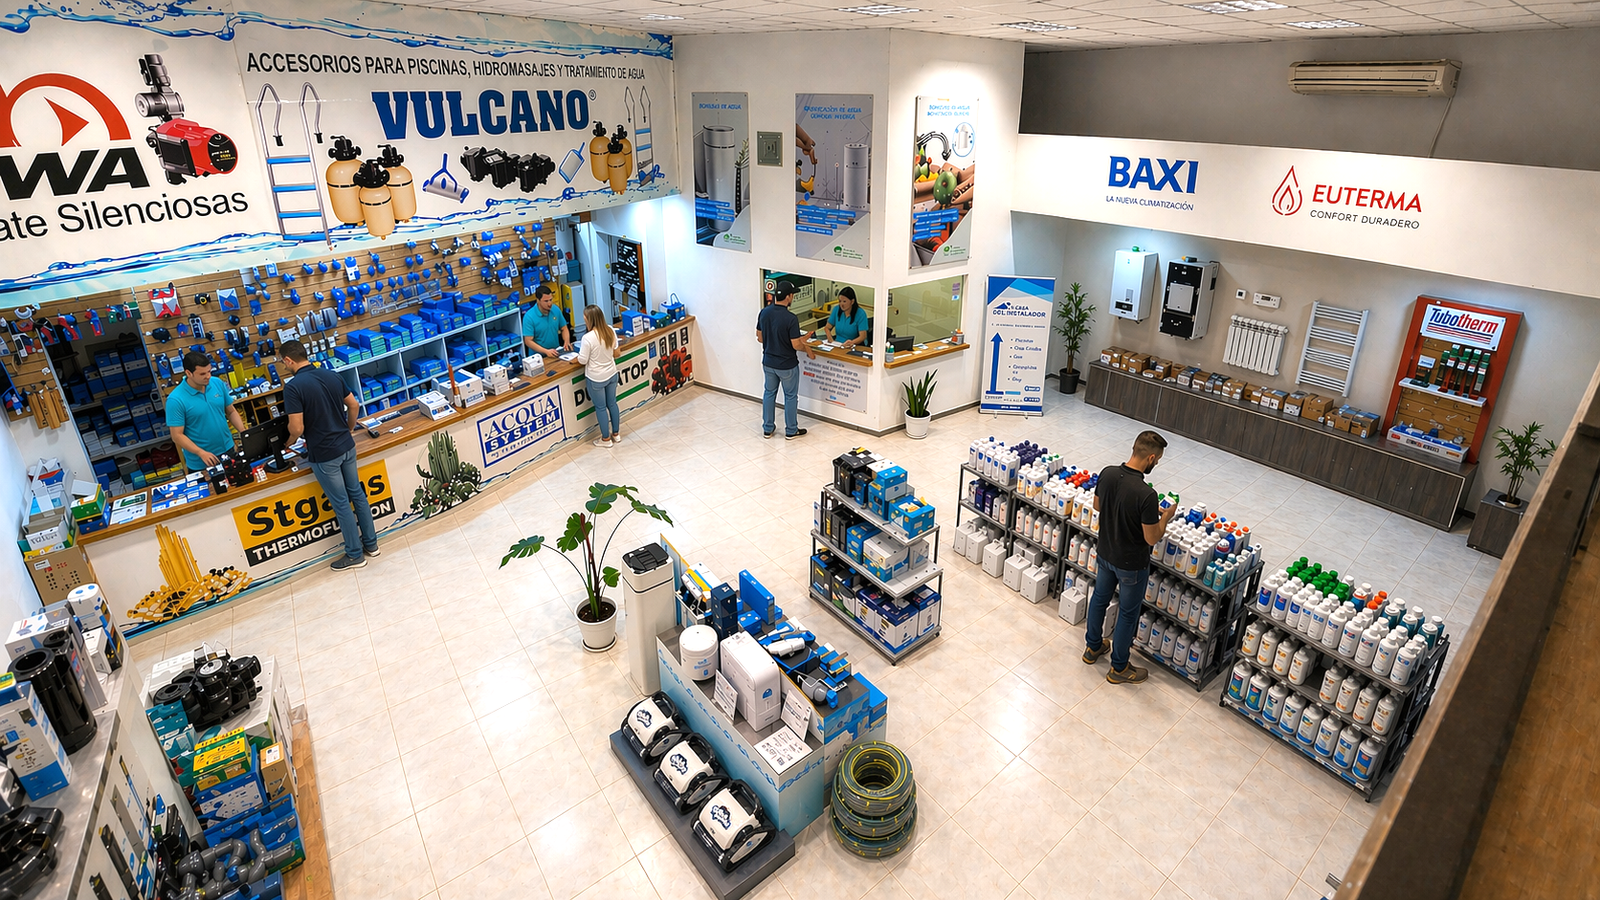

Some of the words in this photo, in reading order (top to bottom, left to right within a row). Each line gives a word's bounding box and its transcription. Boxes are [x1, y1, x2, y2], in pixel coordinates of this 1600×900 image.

[247, 52, 361, 73] ACCESORIOS
[364, 56, 405, 74] PARA
[407, 58, 471, 79] PISCINAS,
[473, 60, 556, 77] HIDROMASAJES
[557, 64, 564, 77] Y
[564, 65, 617, 79] TRATAMIENTO
[617, 67, 627, 79] DE
[628, 68, 646, 80] AGUA
[1108, 155, 1199, 194] BAXI
[57, 192, 249, 233] Silenciosas
[1106, 195, 1114, 203] LA
[1115, 196, 1138, 205] NUEVA
[1312, 184, 1422, 213] EUTERMA
[1309, 209, 1358, 222] CONFORT
[1361, 215, 1420, 230] DURADERO
[1430, 307, 1499, 334] Tubotherm
[486, 394, 557, 441] ACQUA
[490, 411, 556, 451] SYSTEM
